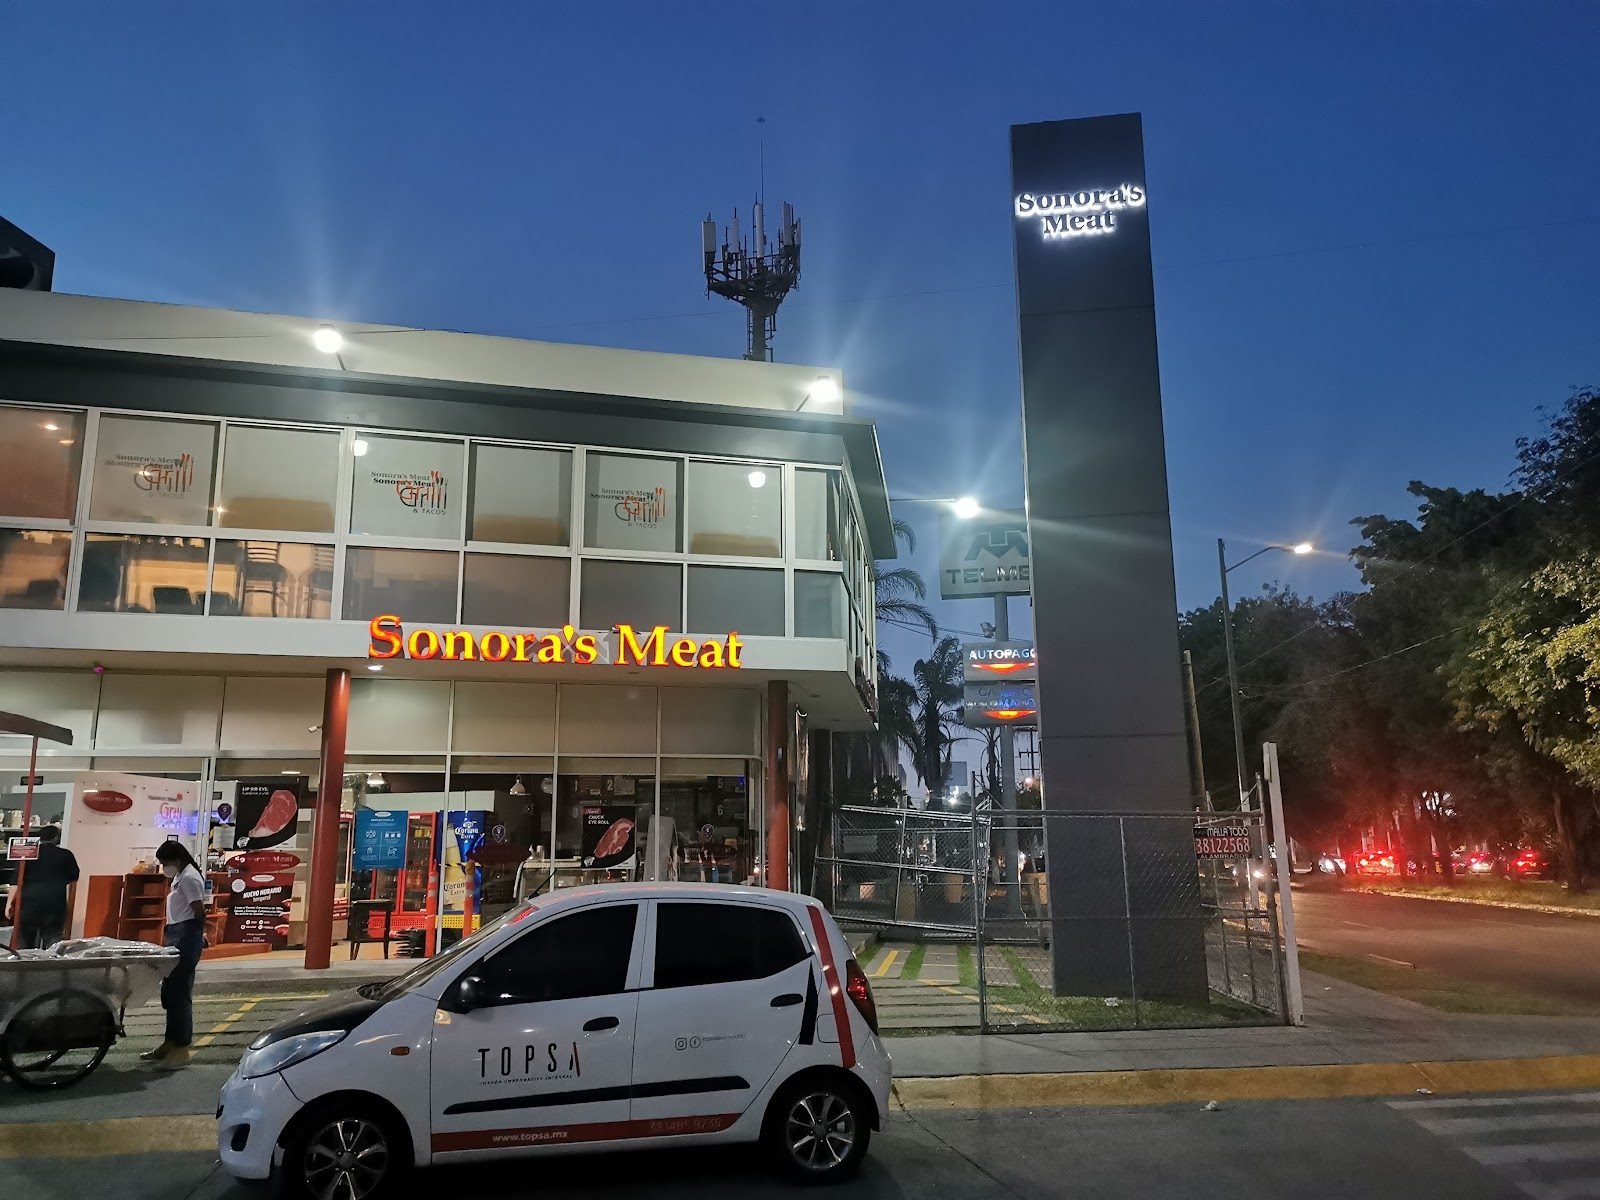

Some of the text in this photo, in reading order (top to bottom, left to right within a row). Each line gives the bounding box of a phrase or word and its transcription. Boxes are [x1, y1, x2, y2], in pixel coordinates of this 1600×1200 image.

[1019, 182, 1143, 212] Sonora's
[1043, 210, 1115, 234] Meat
[368, 615, 743, 668] Sonora's Meat
[606, 779, 613, 791] 2
[717, 804, 724, 816] 6
[455, 827, 478, 835] Corona
[1207, 827, 1249, 837] MALLA TODO
[1195, 837, 1251, 854] 38122568
[242, 886, 282, 899] NUEVO HORARIO
[444, 882, 465, 891] Coron
[477, 1041, 581, 1078] TOPSA
[492, 1130, 568, 1143] www.topsa.mx
